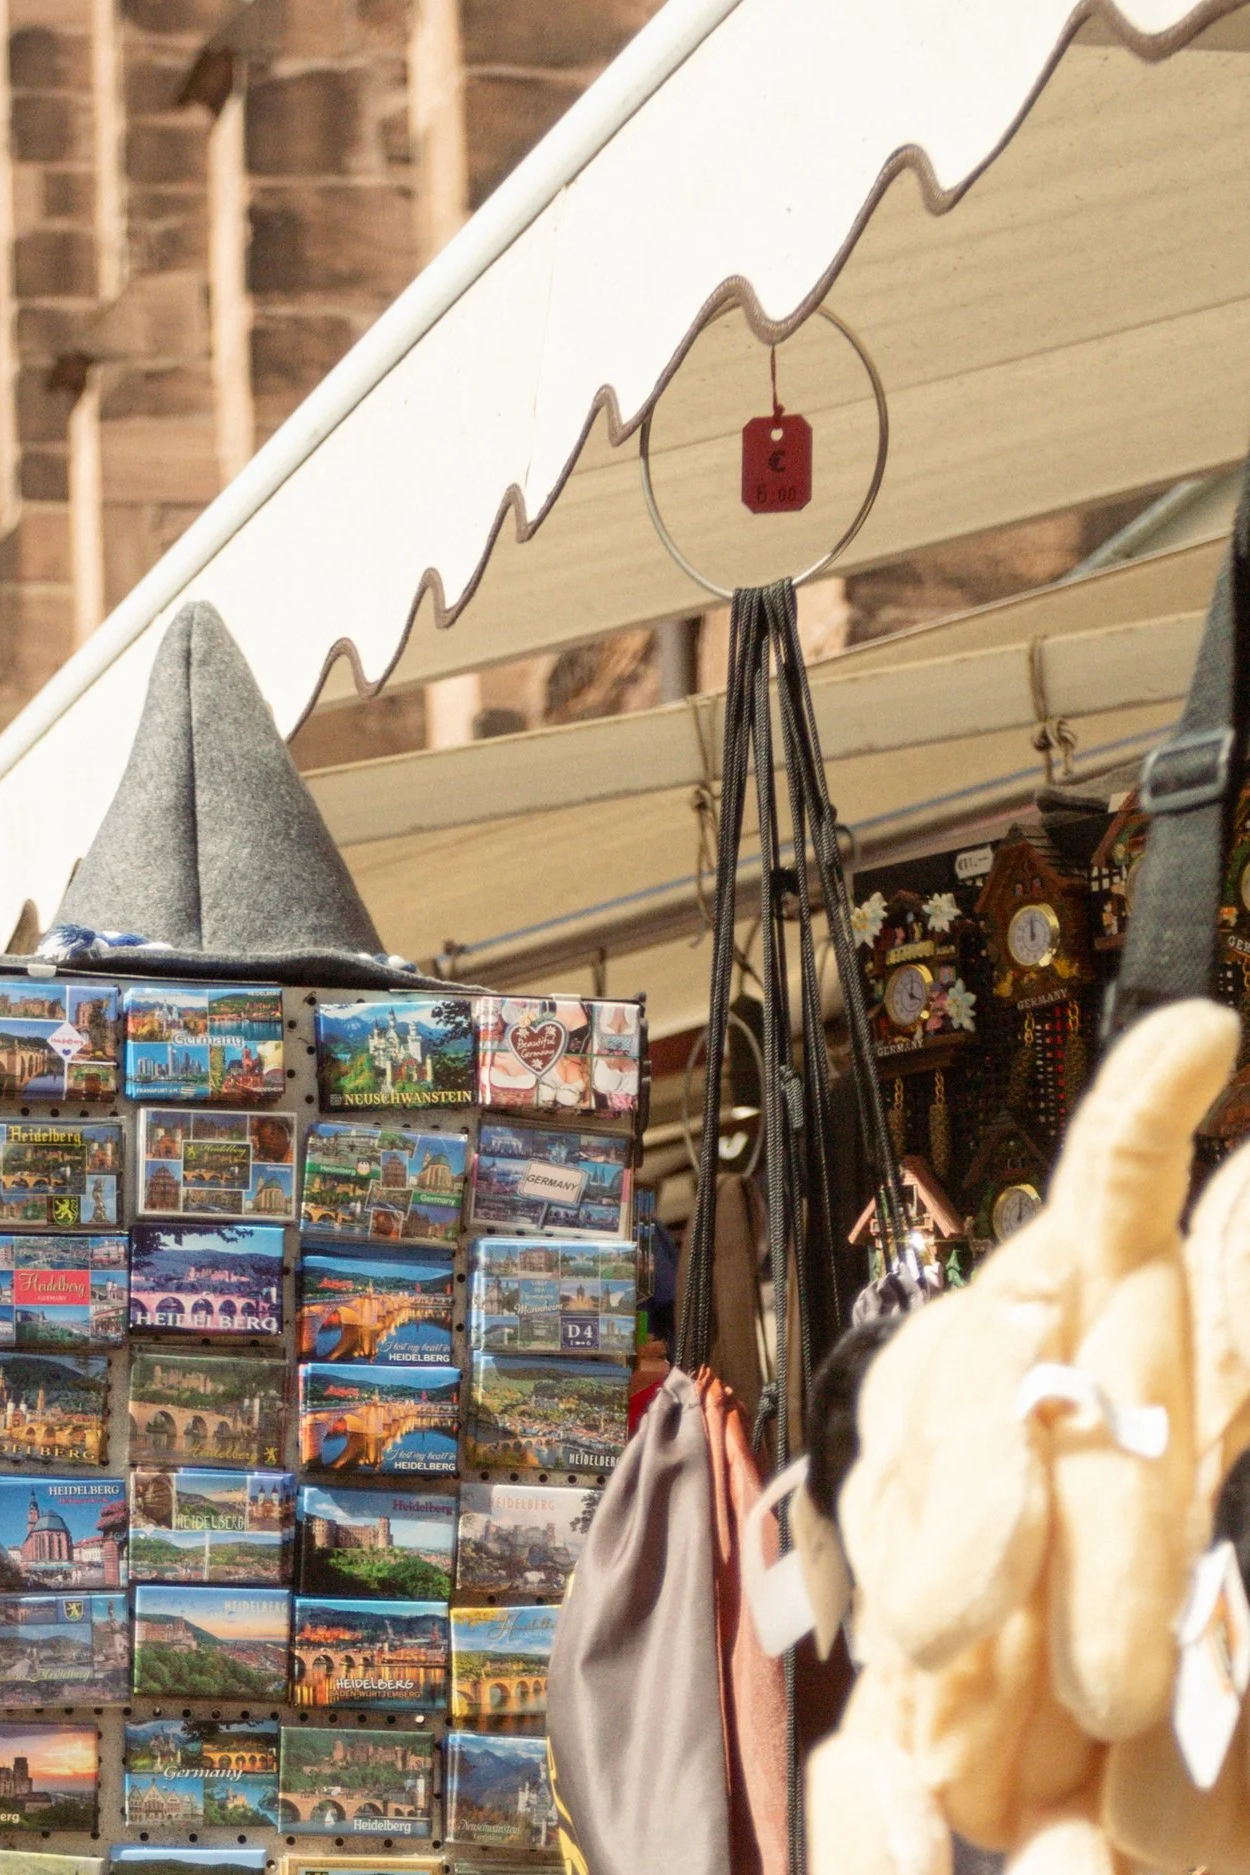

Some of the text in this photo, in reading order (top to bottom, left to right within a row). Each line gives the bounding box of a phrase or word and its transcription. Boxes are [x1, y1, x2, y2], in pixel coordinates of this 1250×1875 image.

[1017, 988, 1069, 1010] GERMANY
[172, 1031, 245, 1048] Germany
[517, 1035, 556, 1050] Beautiful
[521, 1048, 556, 1059] Germany
[877, 1038, 925, 1058] GERMANY
[344, 1090, 473, 1106] NEUSCHWANSTEIN
[8, 1125, 82, 1147] Heidelberg
[320, 1161, 357, 1176] Heidelberg
[526, 1174, 579, 1192] GERMANY
[420, 1193, 456, 1206] Germany
[19, 1272, 86, 1298] Heidelberg
[135, 1310, 278, 1334] HEIDELBERG
[568, 1325, 593, 1338] D 4
[388, 1353, 451, 1363] HEIDELBERG
[183, 1443, 258, 1465] Heidelberg
[394, 1461, 456, 1471] HEIDELBERG
[49, 1485, 120, 1496] HEIDELBERG
[392, 1500, 454, 1515] Heidelberg
[489, 1498, 555, 1511] HEIDELBERG
[175, 1514, 247, 1531] HEIDELBERG
[224, 1600, 289, 1614] HEIDELBERG
[336, 1677, 414, 1690] HEIDELBERG
[163, 1765, 244, 1782] Germany
[353, 1819, 411, 1834] Heidelberg
